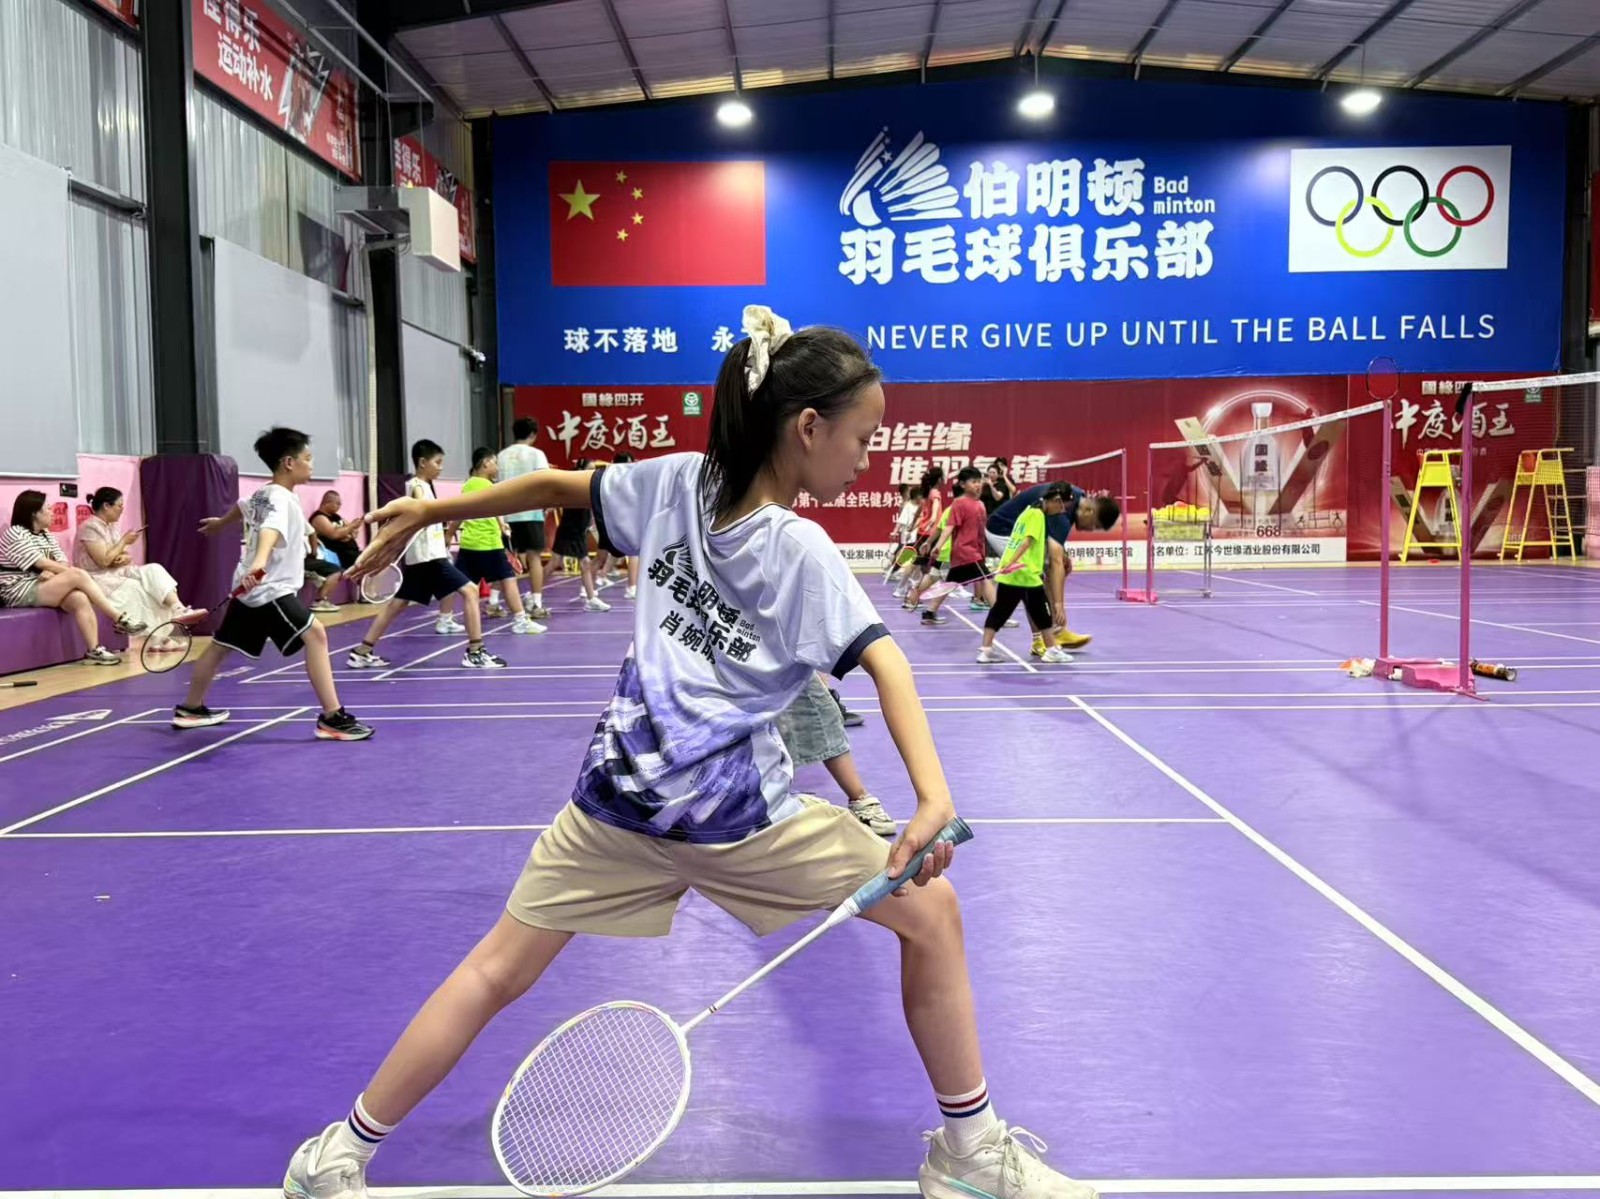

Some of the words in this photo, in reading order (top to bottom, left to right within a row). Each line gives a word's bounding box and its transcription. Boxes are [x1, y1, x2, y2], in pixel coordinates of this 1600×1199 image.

[218, 30, 274, 101] 运动补水
[964, 157, 1145, 219] 伯明顿
[1153, 195, 1216, 215] minton
[1154, 176, 1189, 194] Bad
[838, 219, 1215, 285] 羽毛球俱乐部
[564, 326, 679, 354] 球不落地
[867, 324, 968, 350] NEVER
[981, 322, 1052, 348] GIVE
[1066, 322, 1108, 347] UP
[1122, 319, 1218, 346] UNTIL
[1231, 317, 1293, 343] THE
[1308, 316, 1386, 341] BALL
[1400, 314, 1494, 339] FALLS
[546, 410, 676, 460] 中度酒王
[1257, 525, 1281, 537] 668
[694, 572, 741, 628] 明顿
